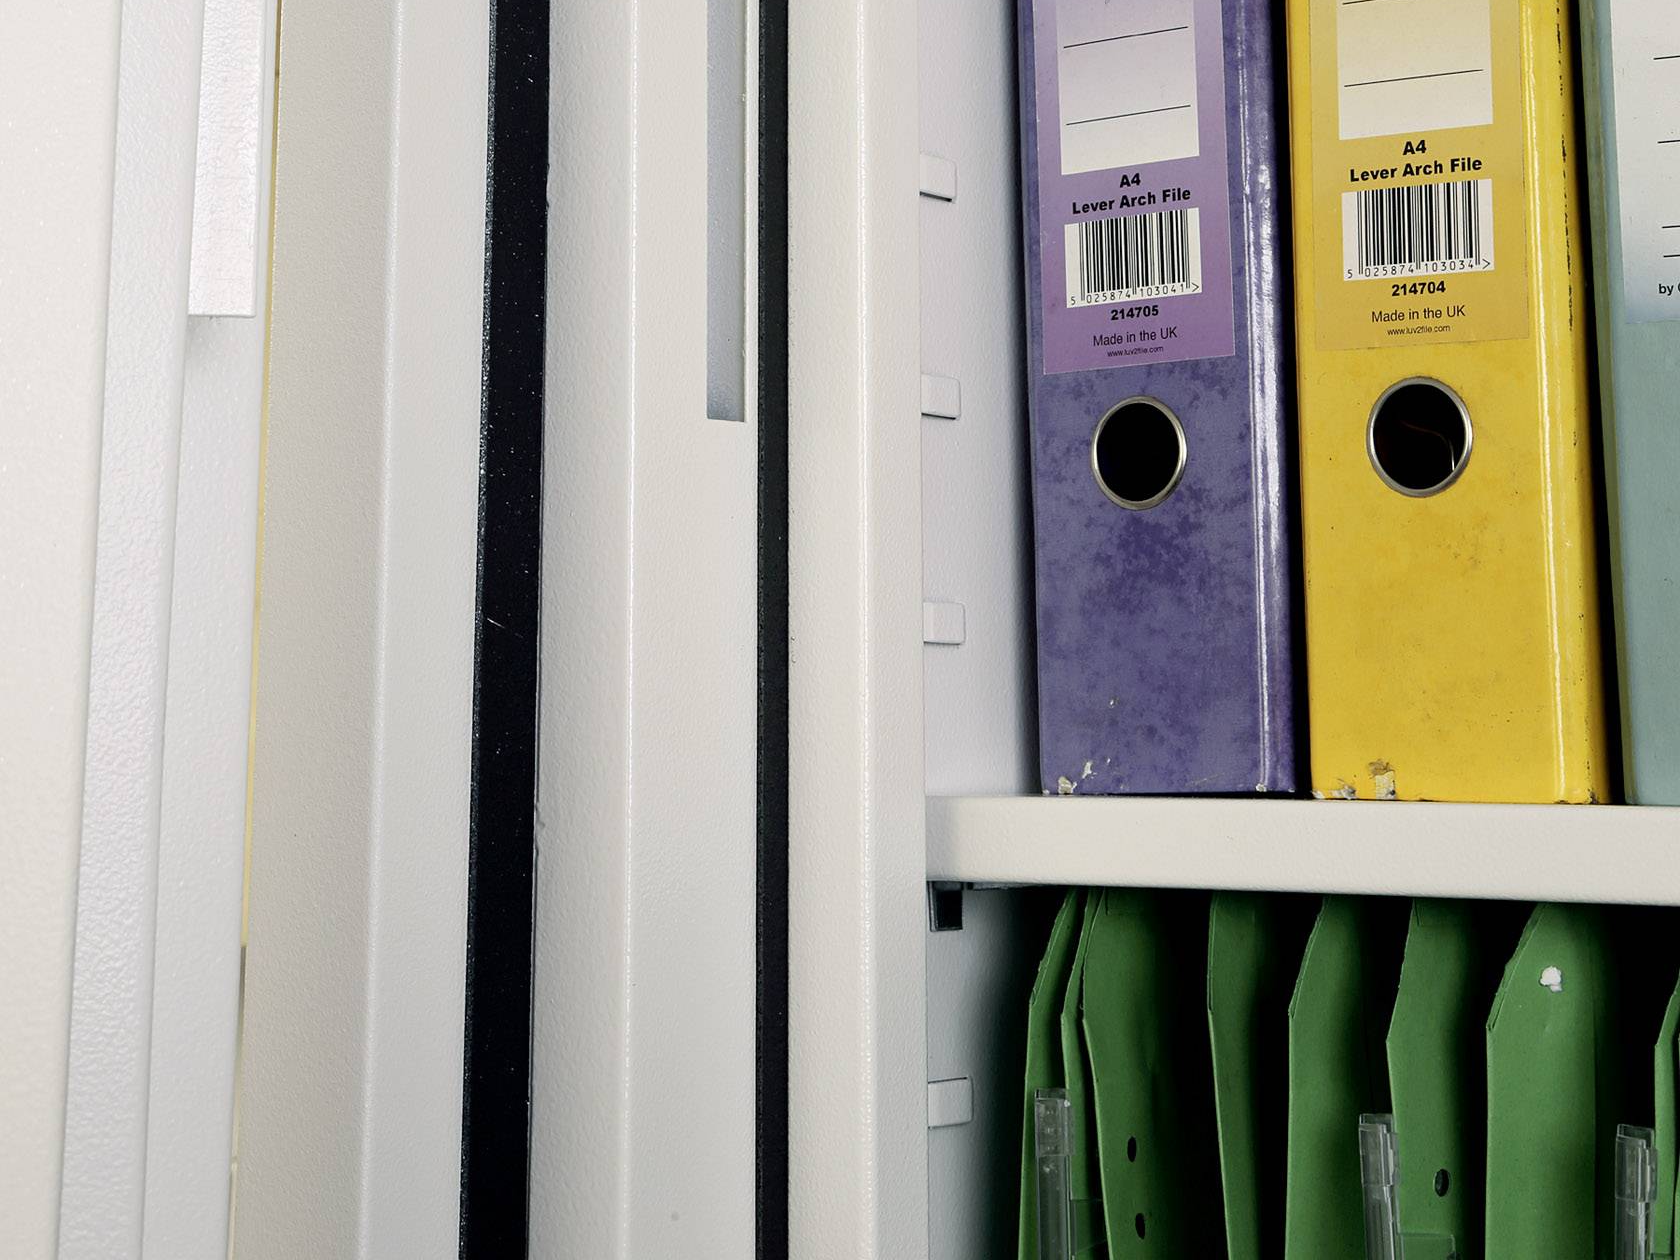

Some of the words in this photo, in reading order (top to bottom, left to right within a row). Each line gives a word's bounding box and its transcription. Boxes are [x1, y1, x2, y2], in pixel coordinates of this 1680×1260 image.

[1402, 139, 1427, 156] A4
[1350, 166, 1398, 183] Lever
[1402, 161, 1444, 177] Arch
[1451, 157, 1483, 173] File
[1119, 173, 1142, 189] A4
[1072, 198, 1115, 215] Lever
[1120, 192, 1156, 209] Arch
[1162, 187, 1191, 203] File
[1391, 280, 1446, 297] 214704
[1658, 283, 1674, 296] by
[1110, 305, 1159, 321] 214705
[1371, 309, 1405, 323] Made
[1408, 308, 1419, 320] in
[1423, 306, 1442, 319] the
[1446, 305, 1466, 317] UK
[1093, 332, 1123, 347] Made
[1126, 330, 1136, 344] in
[1139, 329, 1157, 342] the
[1160, 326, 1178, 340] UK
[1387, 324, 1451, 336] www.luv2file.com
